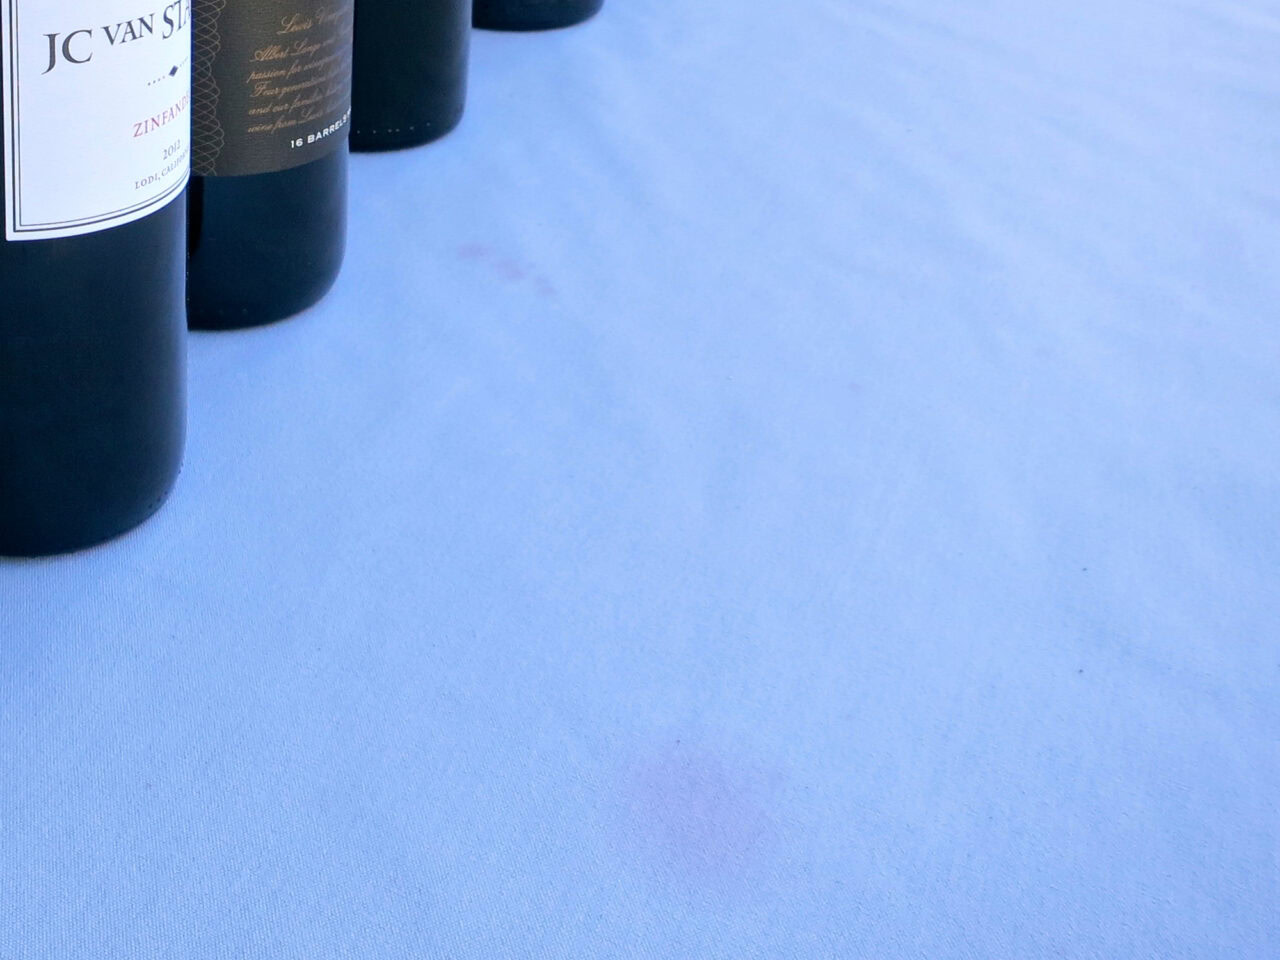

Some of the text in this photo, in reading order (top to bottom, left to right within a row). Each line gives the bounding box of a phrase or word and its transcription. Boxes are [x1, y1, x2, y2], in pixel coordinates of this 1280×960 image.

[41, 29, 93, 76] JC
[100, 12, 156, 46] VAN
[246, 70, 287, 84] passion
[248, 102, 272, 116] and
[272, 102, 290, 114] our
[290, 137, 304, 149] 16
[134, 172, 161, 190] LODI,
